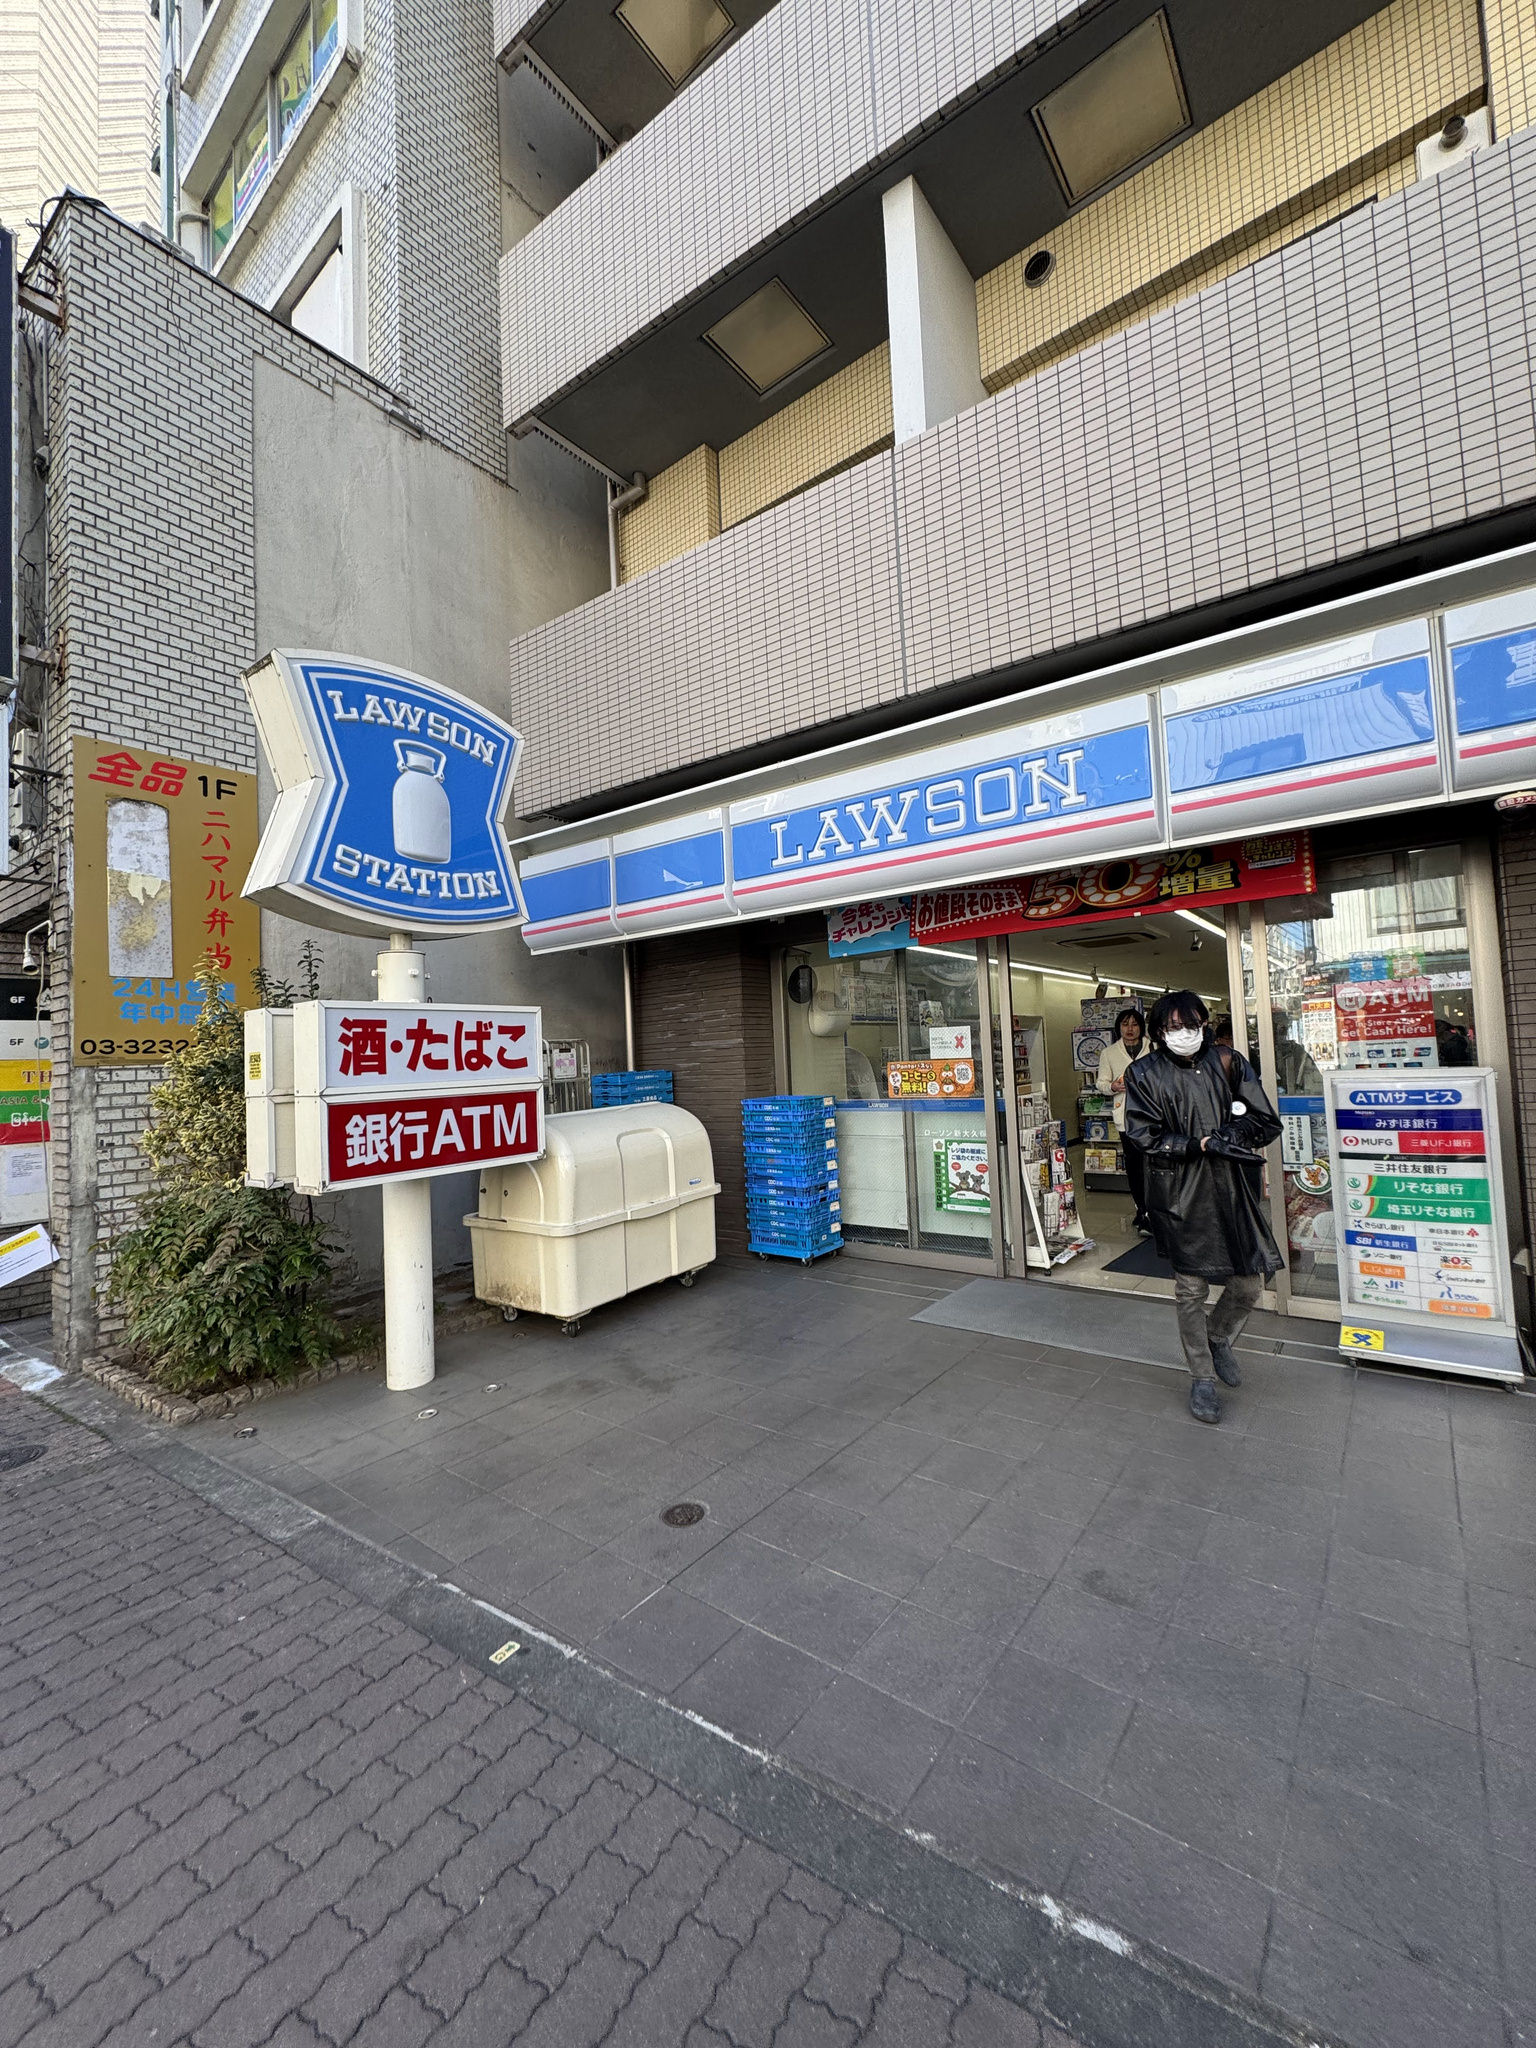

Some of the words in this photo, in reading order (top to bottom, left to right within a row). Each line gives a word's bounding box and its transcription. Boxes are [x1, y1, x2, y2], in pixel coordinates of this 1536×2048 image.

[327, 690, 498, 768] LAWSON
[88, 751, 187, 797] 全品
[197, 775, 238, 800] 1F
[770, 747, 1088, 870] LAWSON
[333, 844, 501, 901] STATION
[1159, 859, 1234, 897] 増量
[841, 900, 886, 926] 今年も
[918, 892, 1019, 929] お値段そのまま
[10, 995, 25, 1004] 6F
[1369, 987, 1430, 1006] ATM
[1341, 1027, 1361, 1038] Get
[1364, 1025, 1394, 1036] Cash
[1397, 1023, 1432, 1035] Here!
[9, 1038, 25, 1046] 5F
[1355, 1091, 1456, 1104] ATMサービス
[1375, 1118, 1438, 1129] みずほ銀行
[345, 1103, 528, 1168] 銀行ATM
[1361, 1138, 1393, 1146] MUFG
[1411, 1139, 1471, 1148] 三菱UFJ銀行
[1374, 1163, 1448, 1175] 三井住友銀行
[1394, 1181, 1464, 1195] りそな銀行
[1388, 1204, 1476, 1218] 埼玉りそな銀行
[1355, 1236, 1372, 1245] SBI
